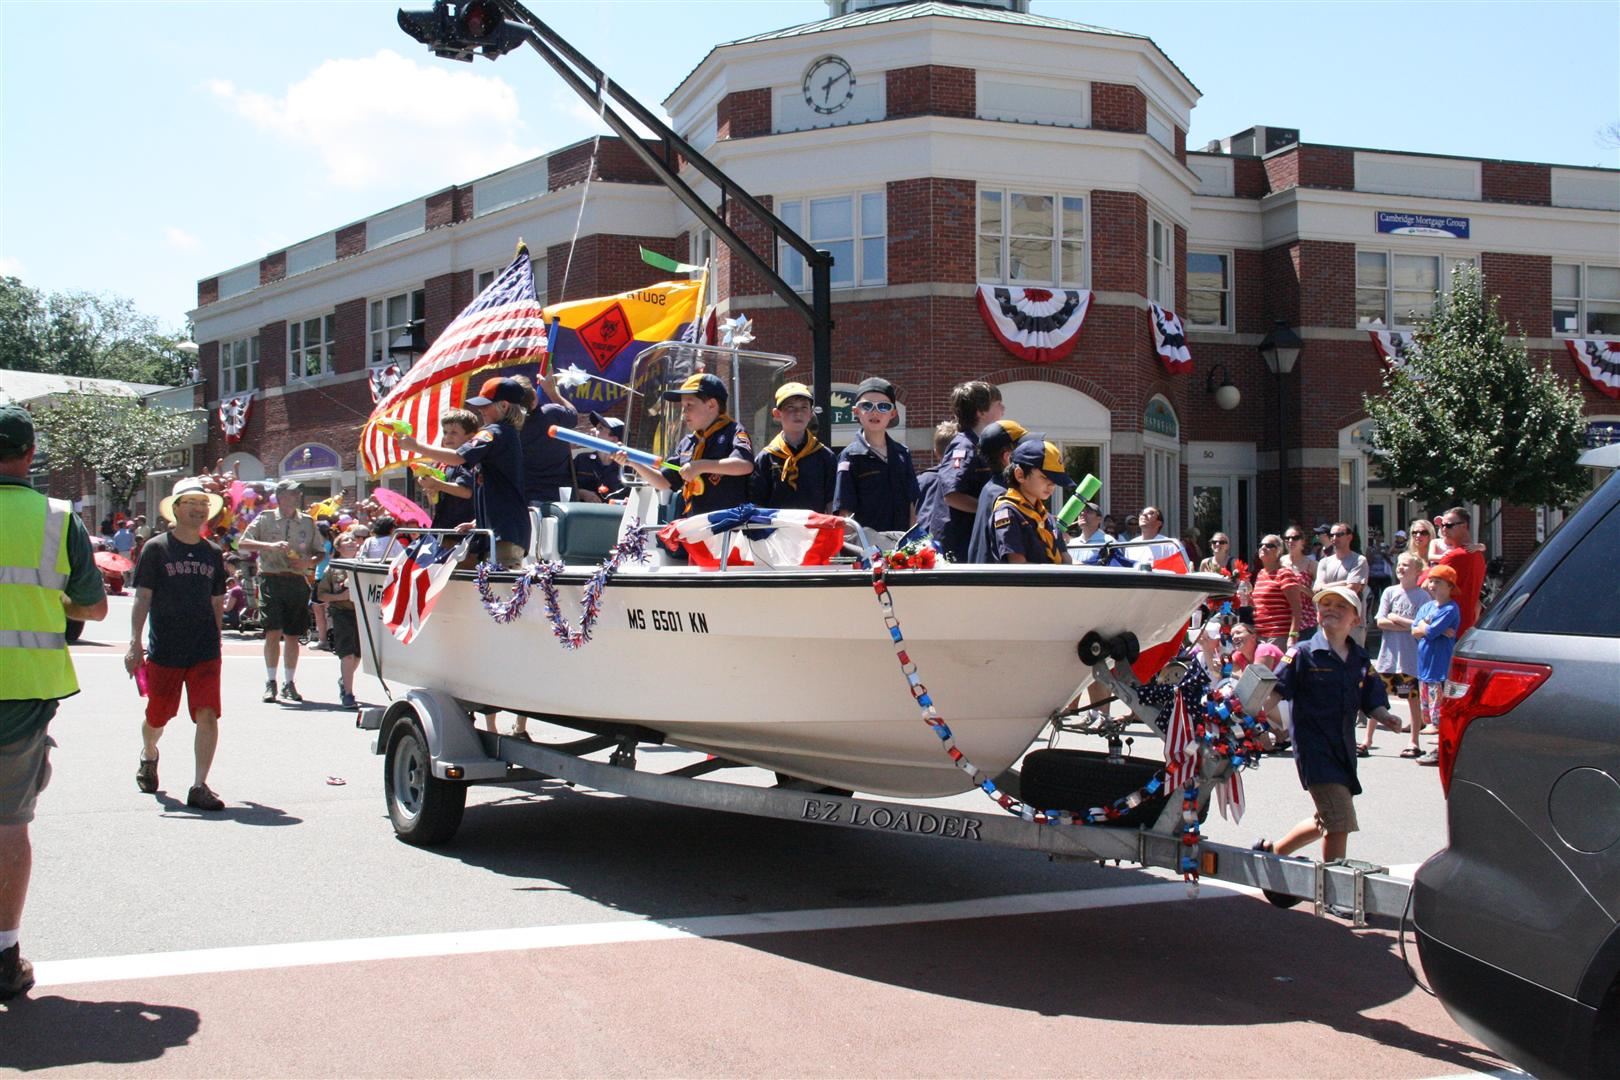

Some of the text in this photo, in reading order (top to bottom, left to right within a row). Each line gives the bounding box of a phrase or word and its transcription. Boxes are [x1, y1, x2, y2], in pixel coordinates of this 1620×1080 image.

[1380, 213, 1467, 230] Cambridge Mortgage Group
[1203, 450, 1215, 459] 50
[165, 560, 214, 578] BOSTON
[627, 608, 709, 634] MS 6501 KN
[800, 799, 982, 841] EZ LOADER
